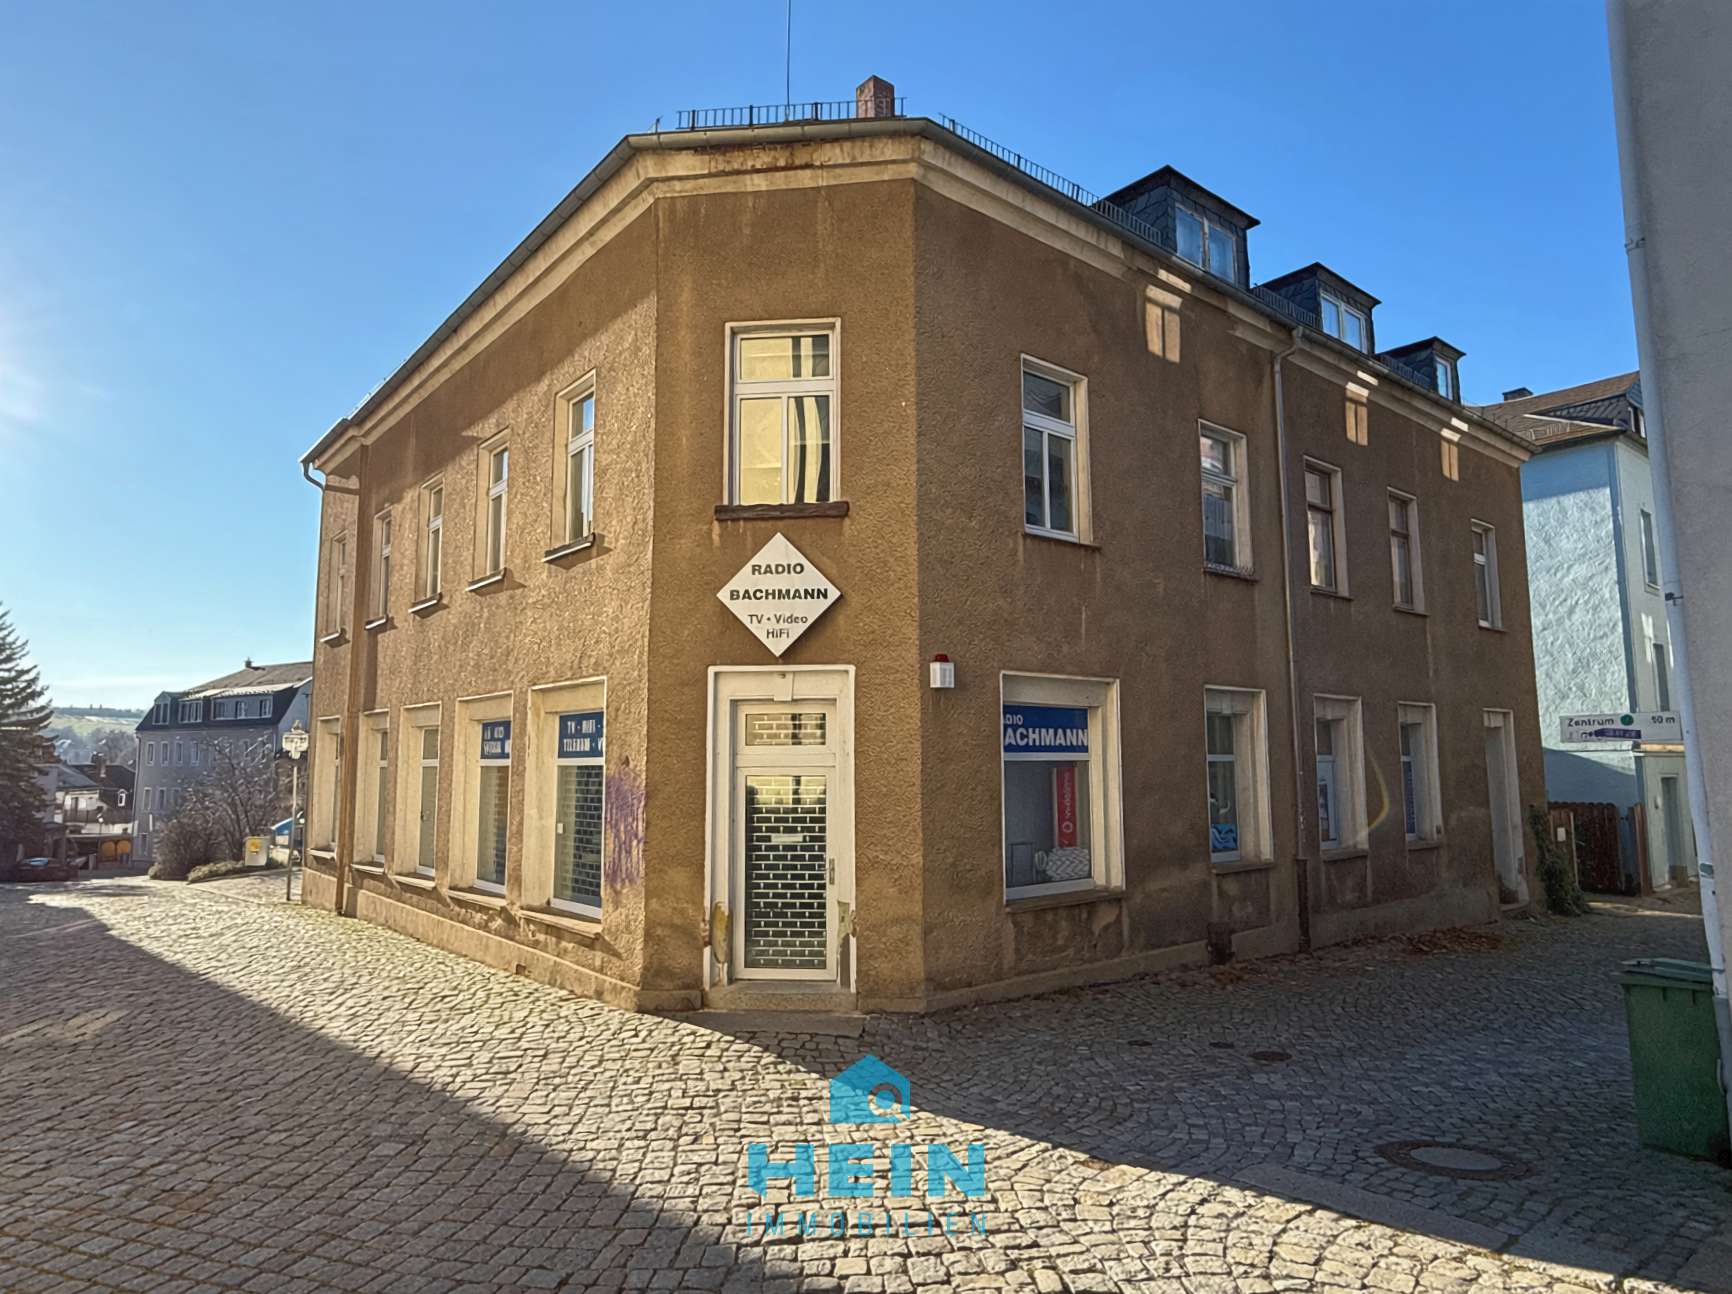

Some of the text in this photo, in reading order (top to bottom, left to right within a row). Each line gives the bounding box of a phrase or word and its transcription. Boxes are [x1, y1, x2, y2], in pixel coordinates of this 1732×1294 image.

[751, 563, 805, 576] RADIO
[729, 588, 829, 601] BACHMANN
[747, 613, 809, 625] TV Video
[766, 628, 790, 639] HiFi
[1004, 713, 1024, 726] DIO
[1567, 717, 1615, 728] Zentrum
[1004, 726, 1088, 746] ACHMANN
